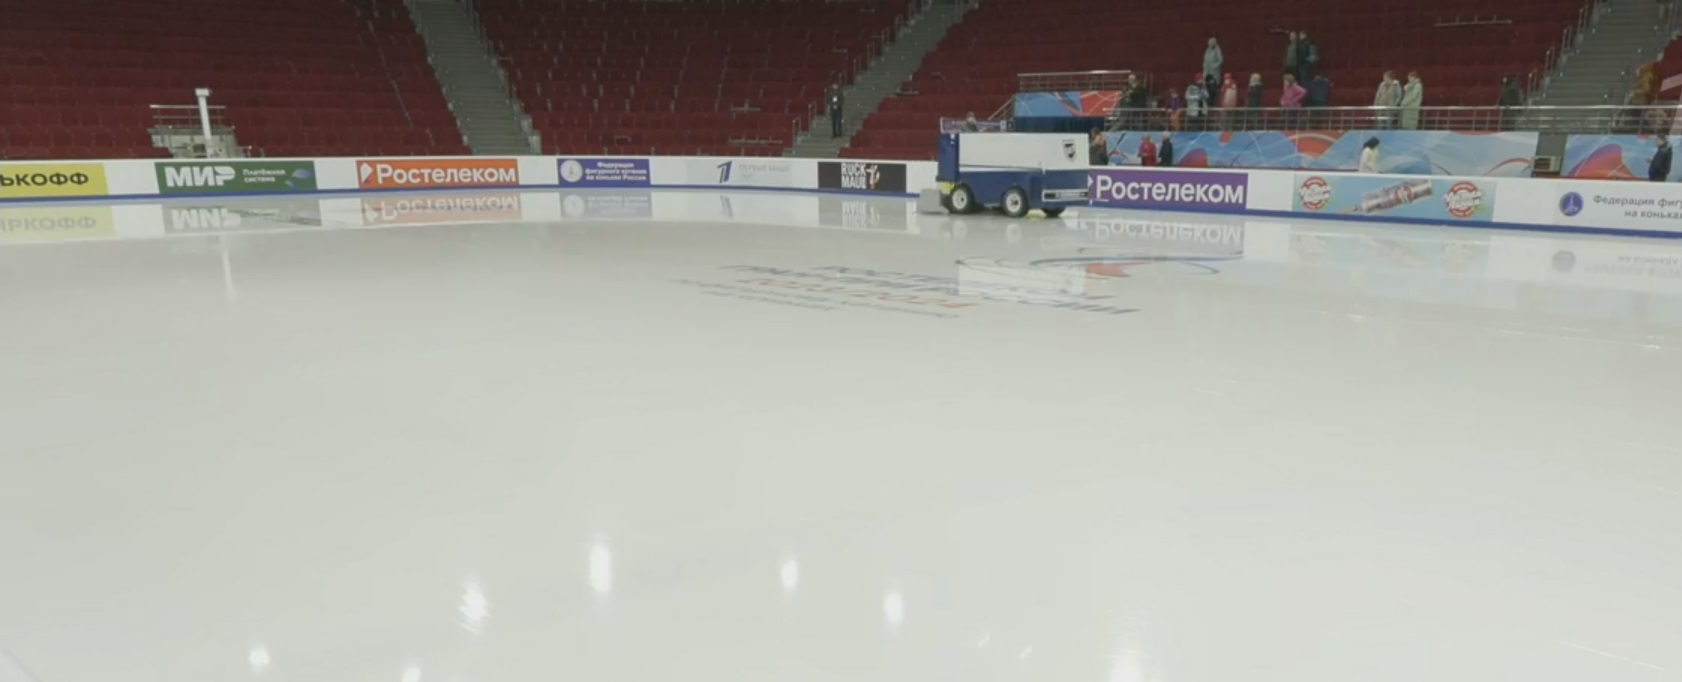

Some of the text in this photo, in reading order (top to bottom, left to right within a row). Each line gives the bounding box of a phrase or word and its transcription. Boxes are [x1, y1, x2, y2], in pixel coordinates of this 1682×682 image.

[164, 166, 236, 187] МИР
[376, 163, 517, 184] Ростелеком
[841, 162, 867, 175] RUCK
[1096, 174, 1243, 204] Ростелеком
[1593, 195, 1655, 206] Федерация
